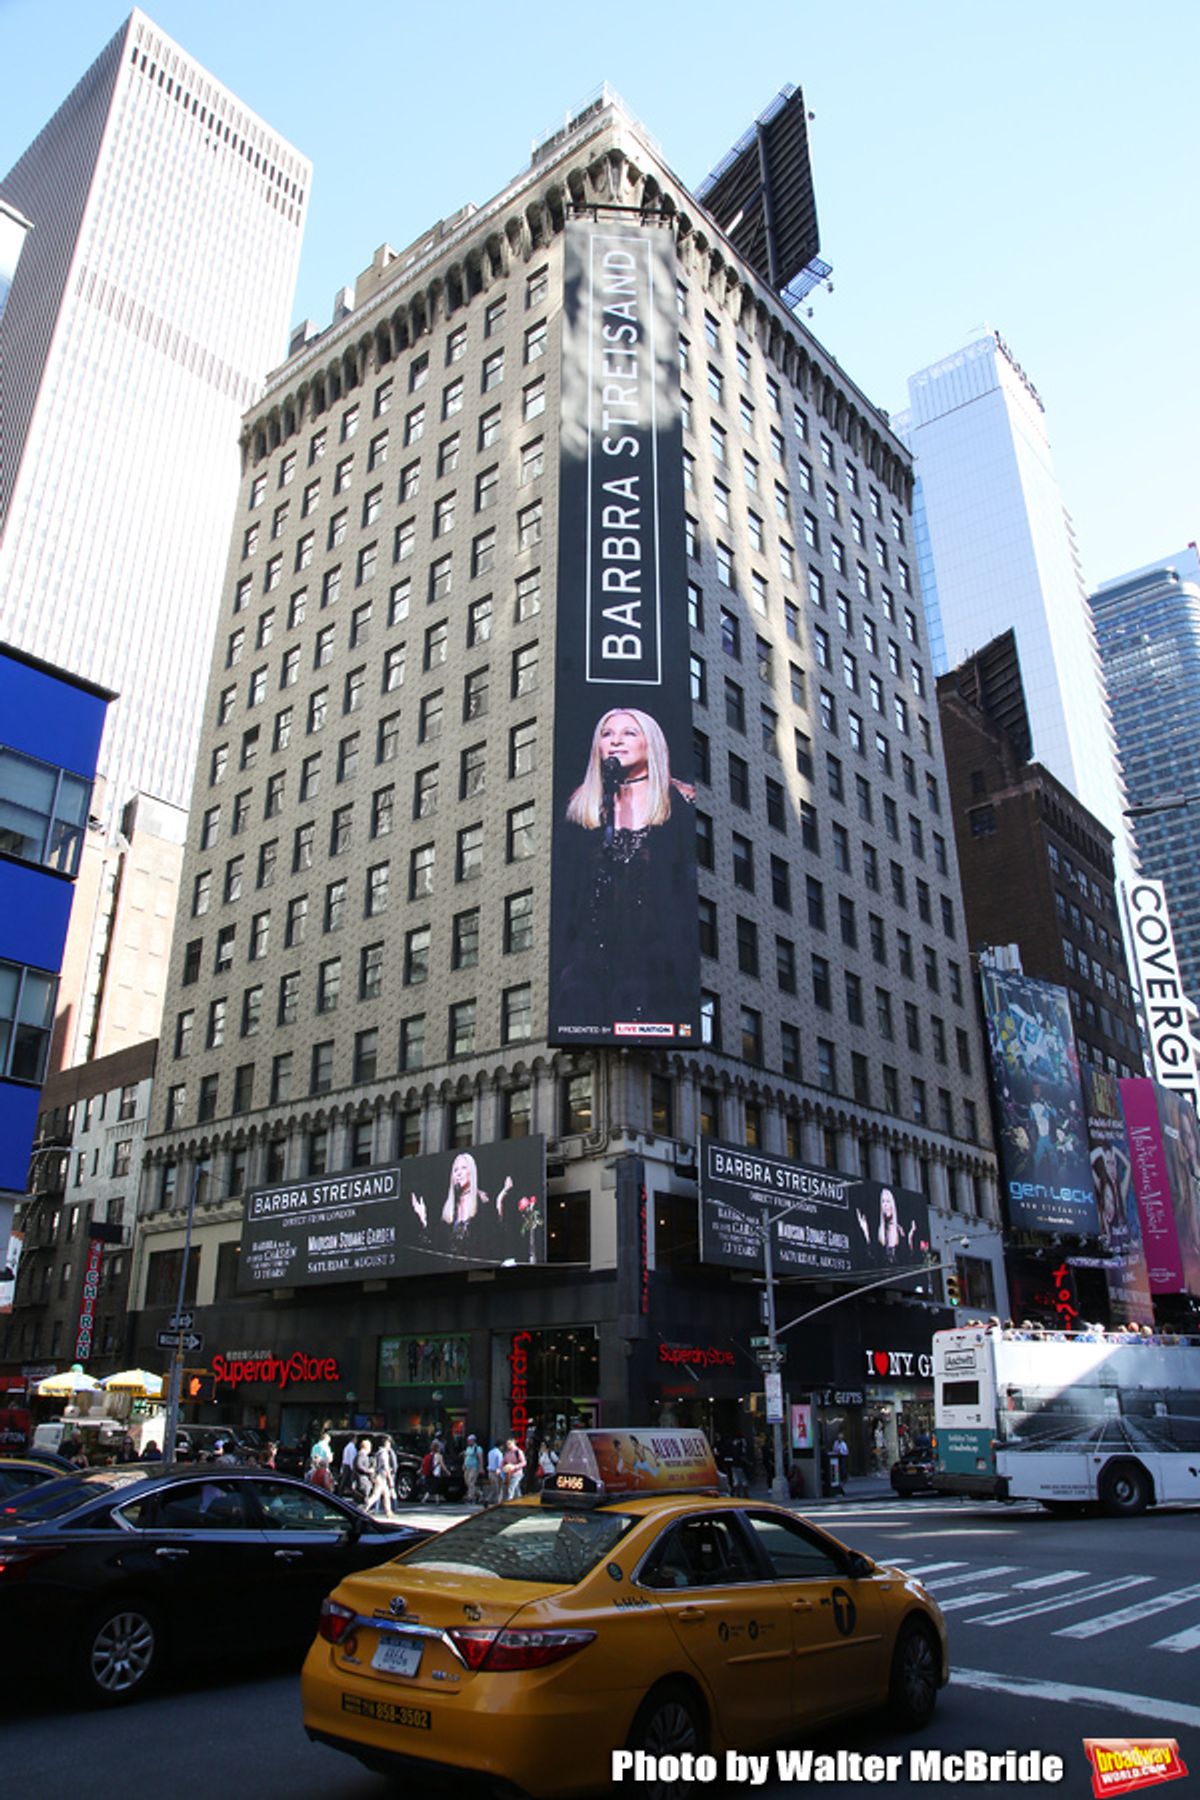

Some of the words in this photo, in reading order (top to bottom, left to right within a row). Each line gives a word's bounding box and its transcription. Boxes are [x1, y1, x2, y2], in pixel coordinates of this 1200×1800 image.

[601, 249, 640, 458] STREISAND
[601, 475, 642, 662] BARBRA
[558, 1025, 600, 1034] PRESENTED
[617, 1025, 638, 1034] LIVE
[638, 1026, 672, 1034] NATION
[254, 1190, 308, 1214] BARBRA
[312, 1175, 394, 1204] STREISAND
[715, 1153, 772, 1184] BARBRA
[776, 1169, 844, 1201] STREISAND
[339, 1230, 365, 1248] SQUARE
[366, 1226, 396, 1244] GARDEN
[76, 1255, 99, 1359] ICHIRAN
[866, 1349, 876, 1375] I
[507, 1330, 533, 1453] uperdry
[834, 1391, 863, 1405] GIFTS
[651, 1437, 682, 1459] ALVIN
[680, 1437, 708, 1458] AILEY
